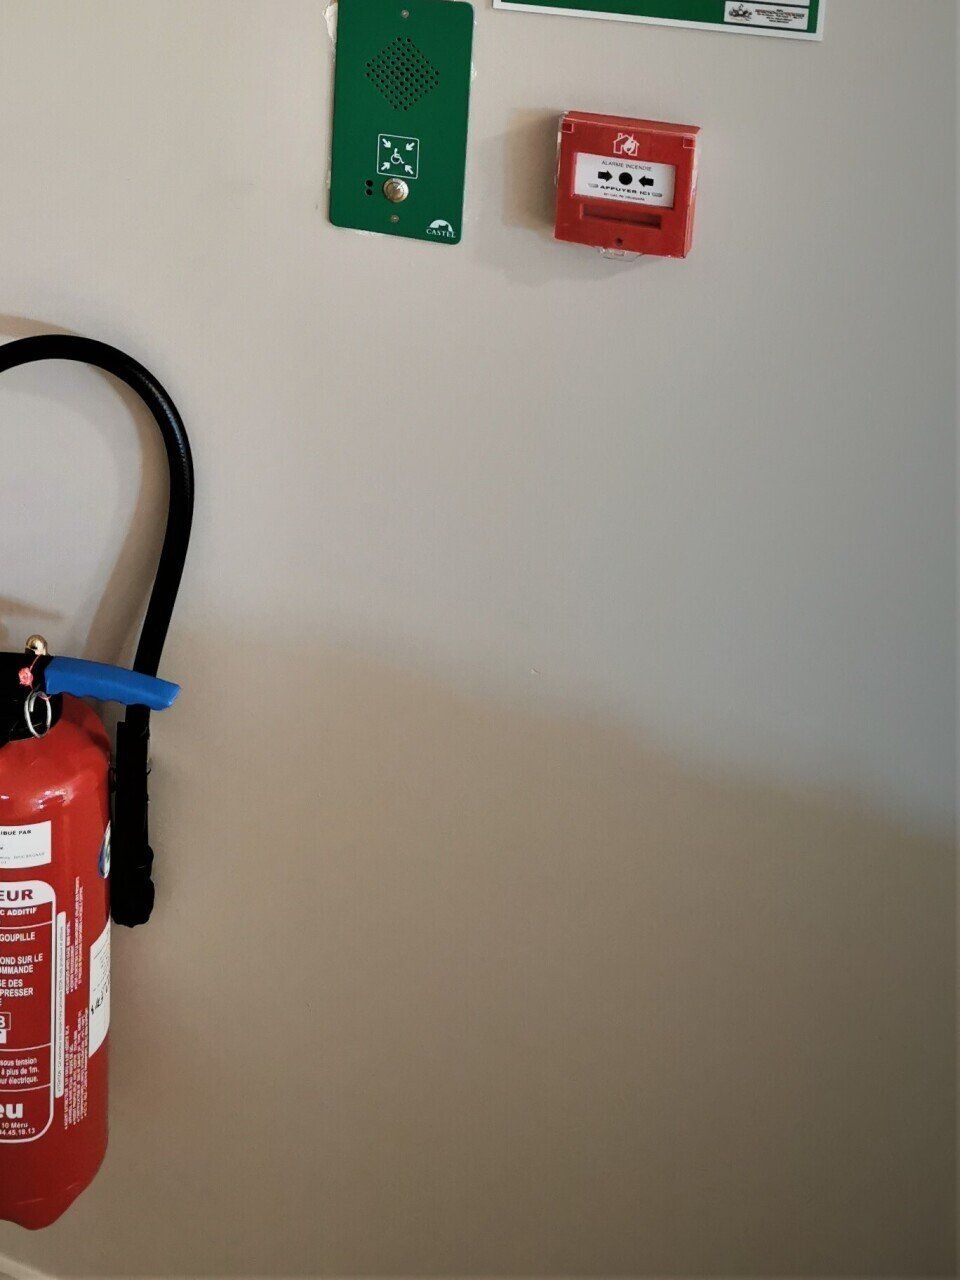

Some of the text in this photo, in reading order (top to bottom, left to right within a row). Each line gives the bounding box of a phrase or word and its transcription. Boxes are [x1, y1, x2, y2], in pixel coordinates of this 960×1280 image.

[600, 185, 637, 194] APPUYER
[426, 228, 456, 238] CASTEL
[7, 907, 38, 916] ADDITIF
[17, 955, 33, 964] SUR
[34, 953, 44, 962] LE
[7, 978, 23, 988] DES
[0, 987, 34, 997] PRESSER
